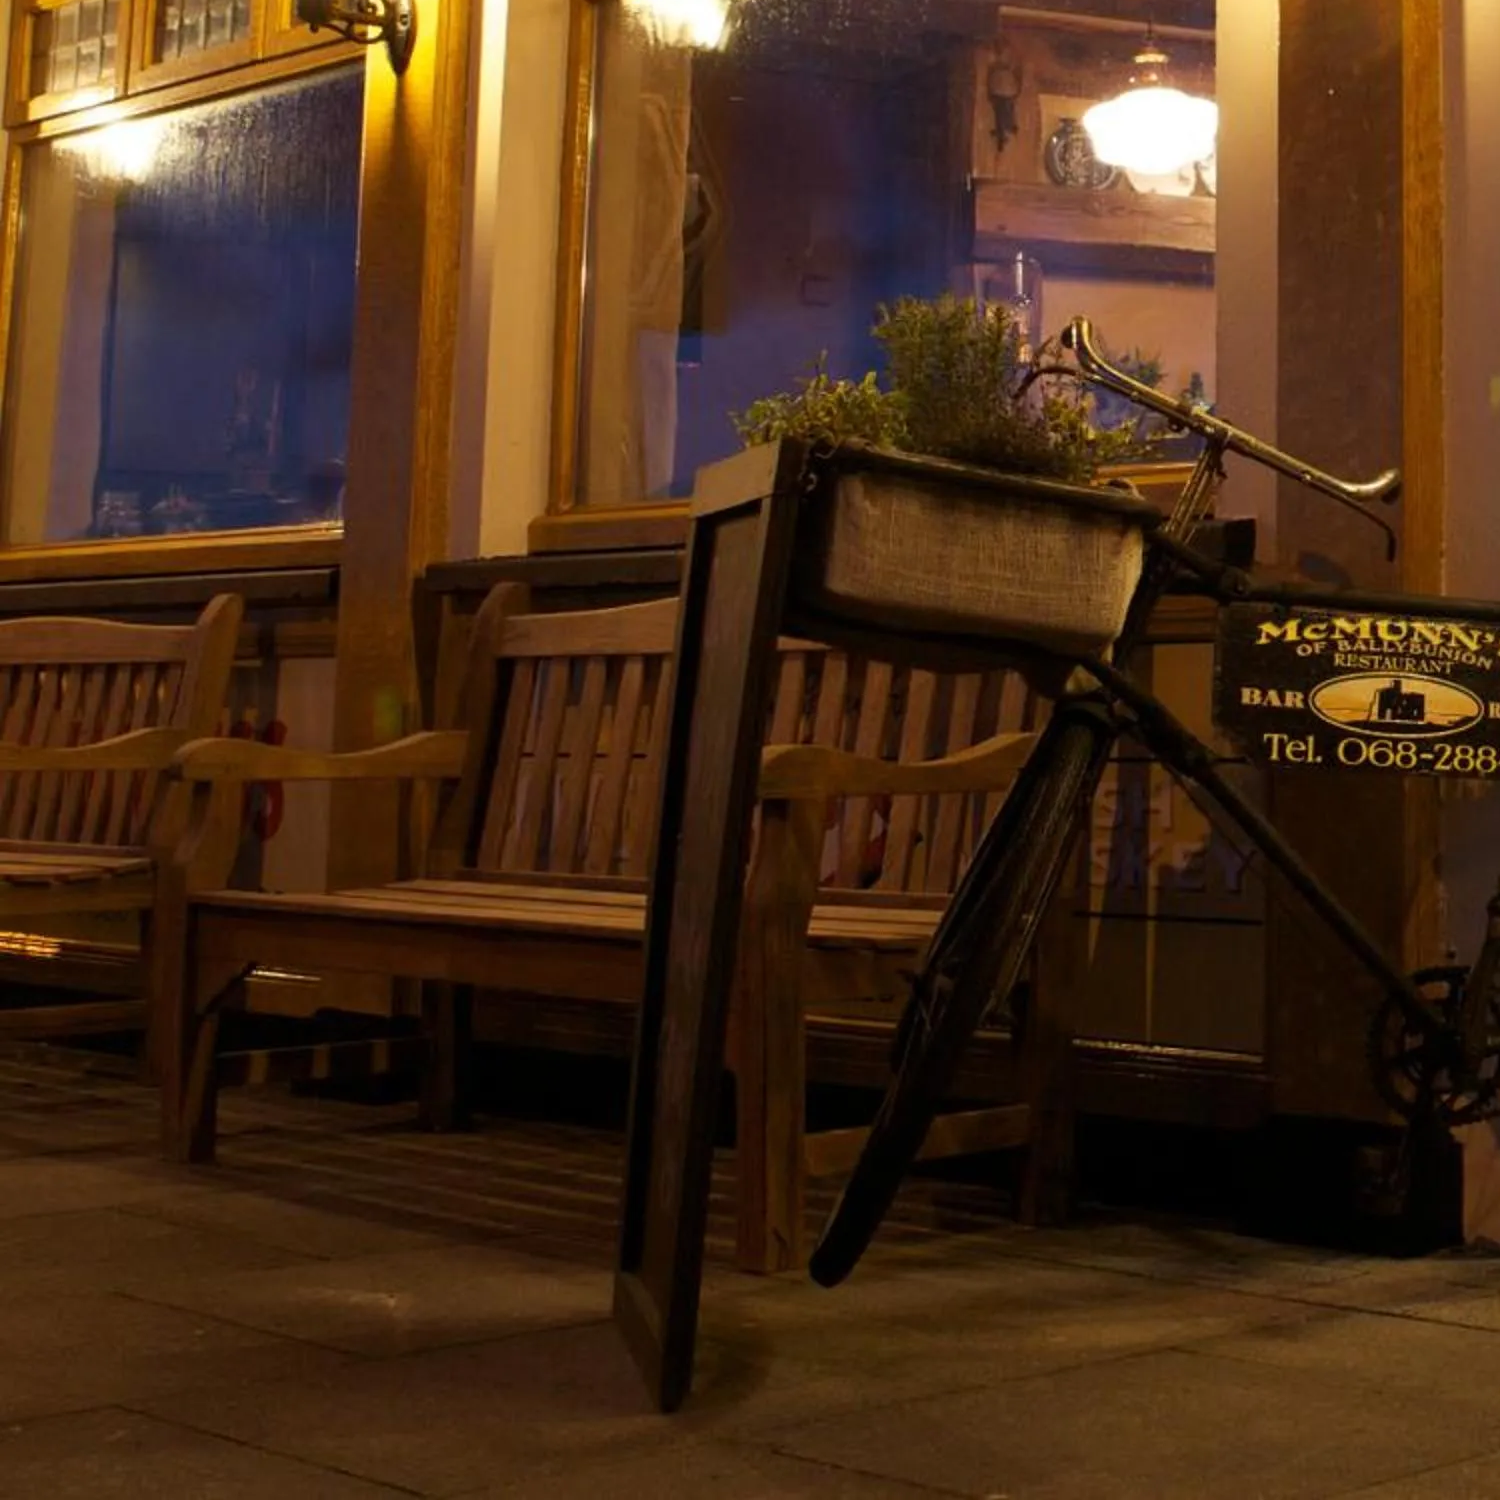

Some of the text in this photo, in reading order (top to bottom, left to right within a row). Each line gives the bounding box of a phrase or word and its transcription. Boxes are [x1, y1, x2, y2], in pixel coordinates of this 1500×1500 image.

[1296, 638, 1493, 670] OF BALLYBUNION
[1334, 654, 1455, 675] RESTAURANT
[1241, 687, 1305, 708] BAR
[1263, 733, 1323, 764] Tel.
